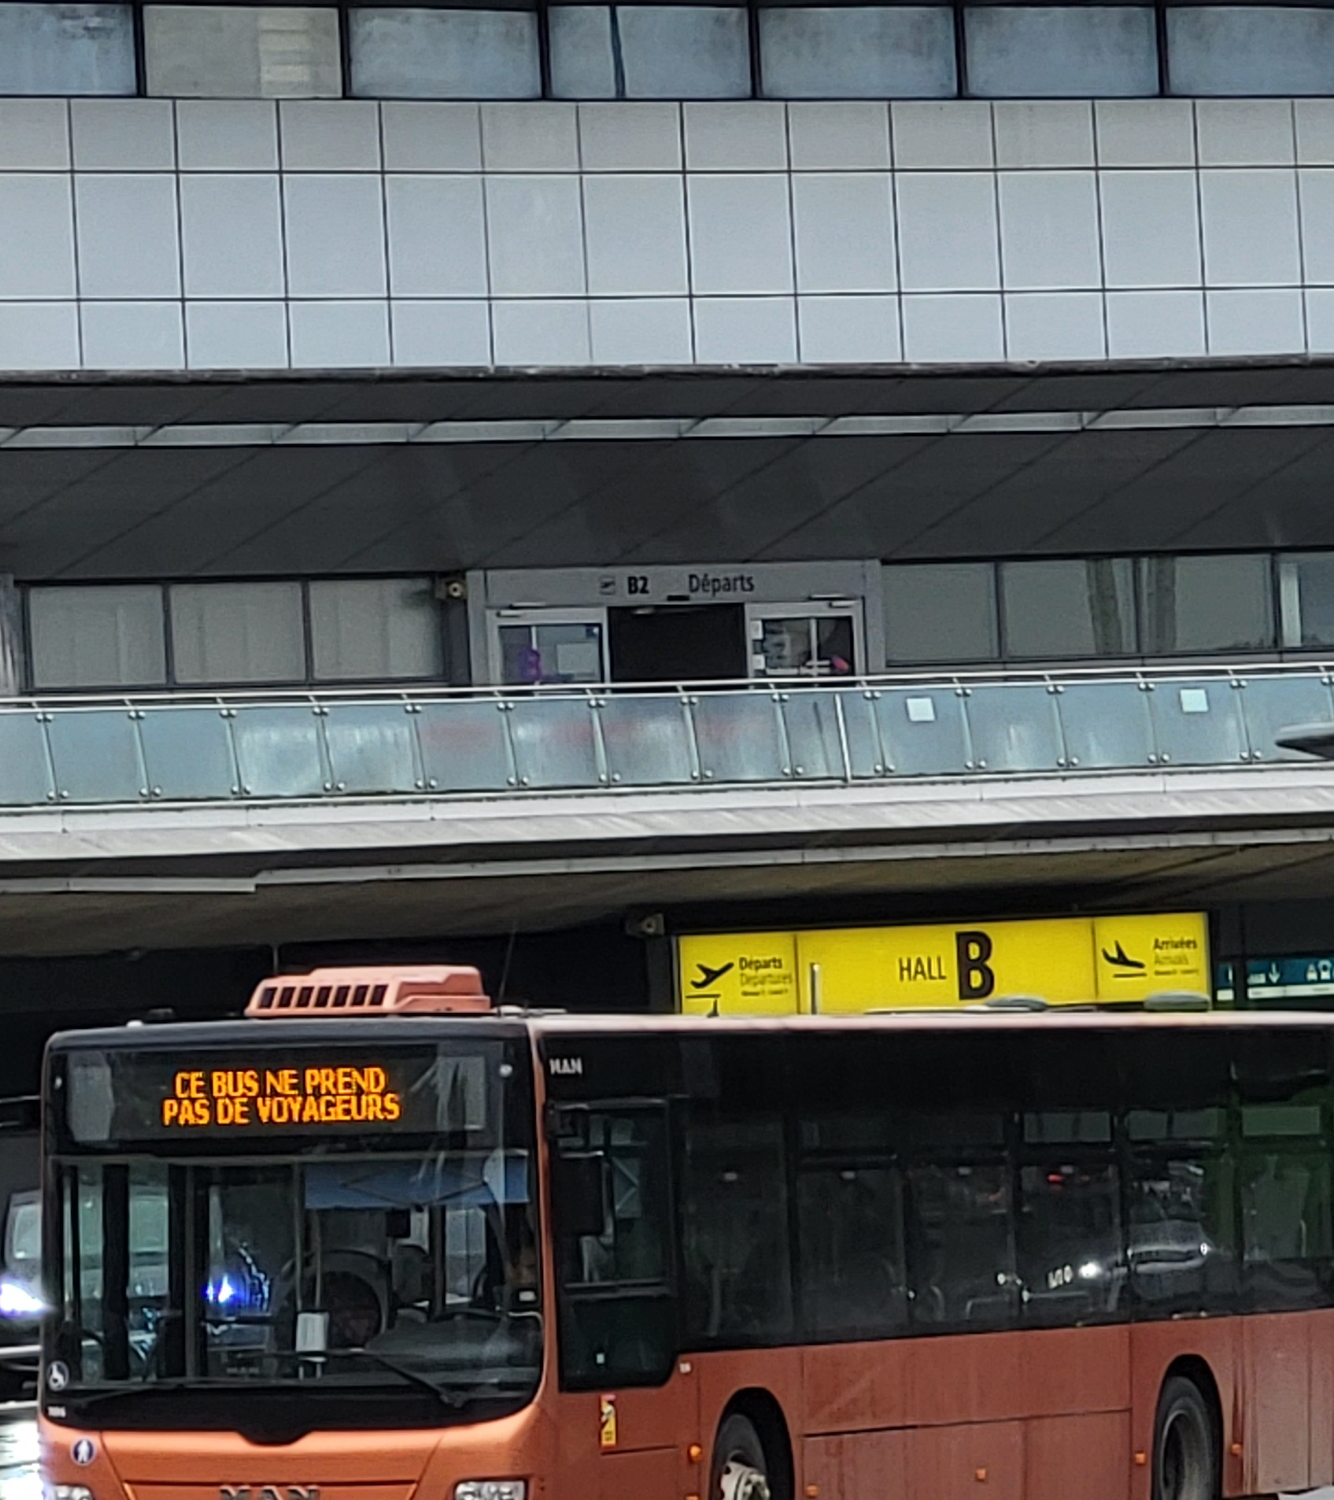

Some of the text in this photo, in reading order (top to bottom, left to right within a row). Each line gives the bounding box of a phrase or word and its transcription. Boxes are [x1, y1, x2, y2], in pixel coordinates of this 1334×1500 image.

[627, 574, 755, 597] B2 Départs
[738, 956, 783, 972] Départs
[898, 930, 995, 1001] HALL B
[175, 1067, 386, 1099] CE BUS NE PREND
[163, 1094, 401, 1126] PAS DE VOYAGEURS
